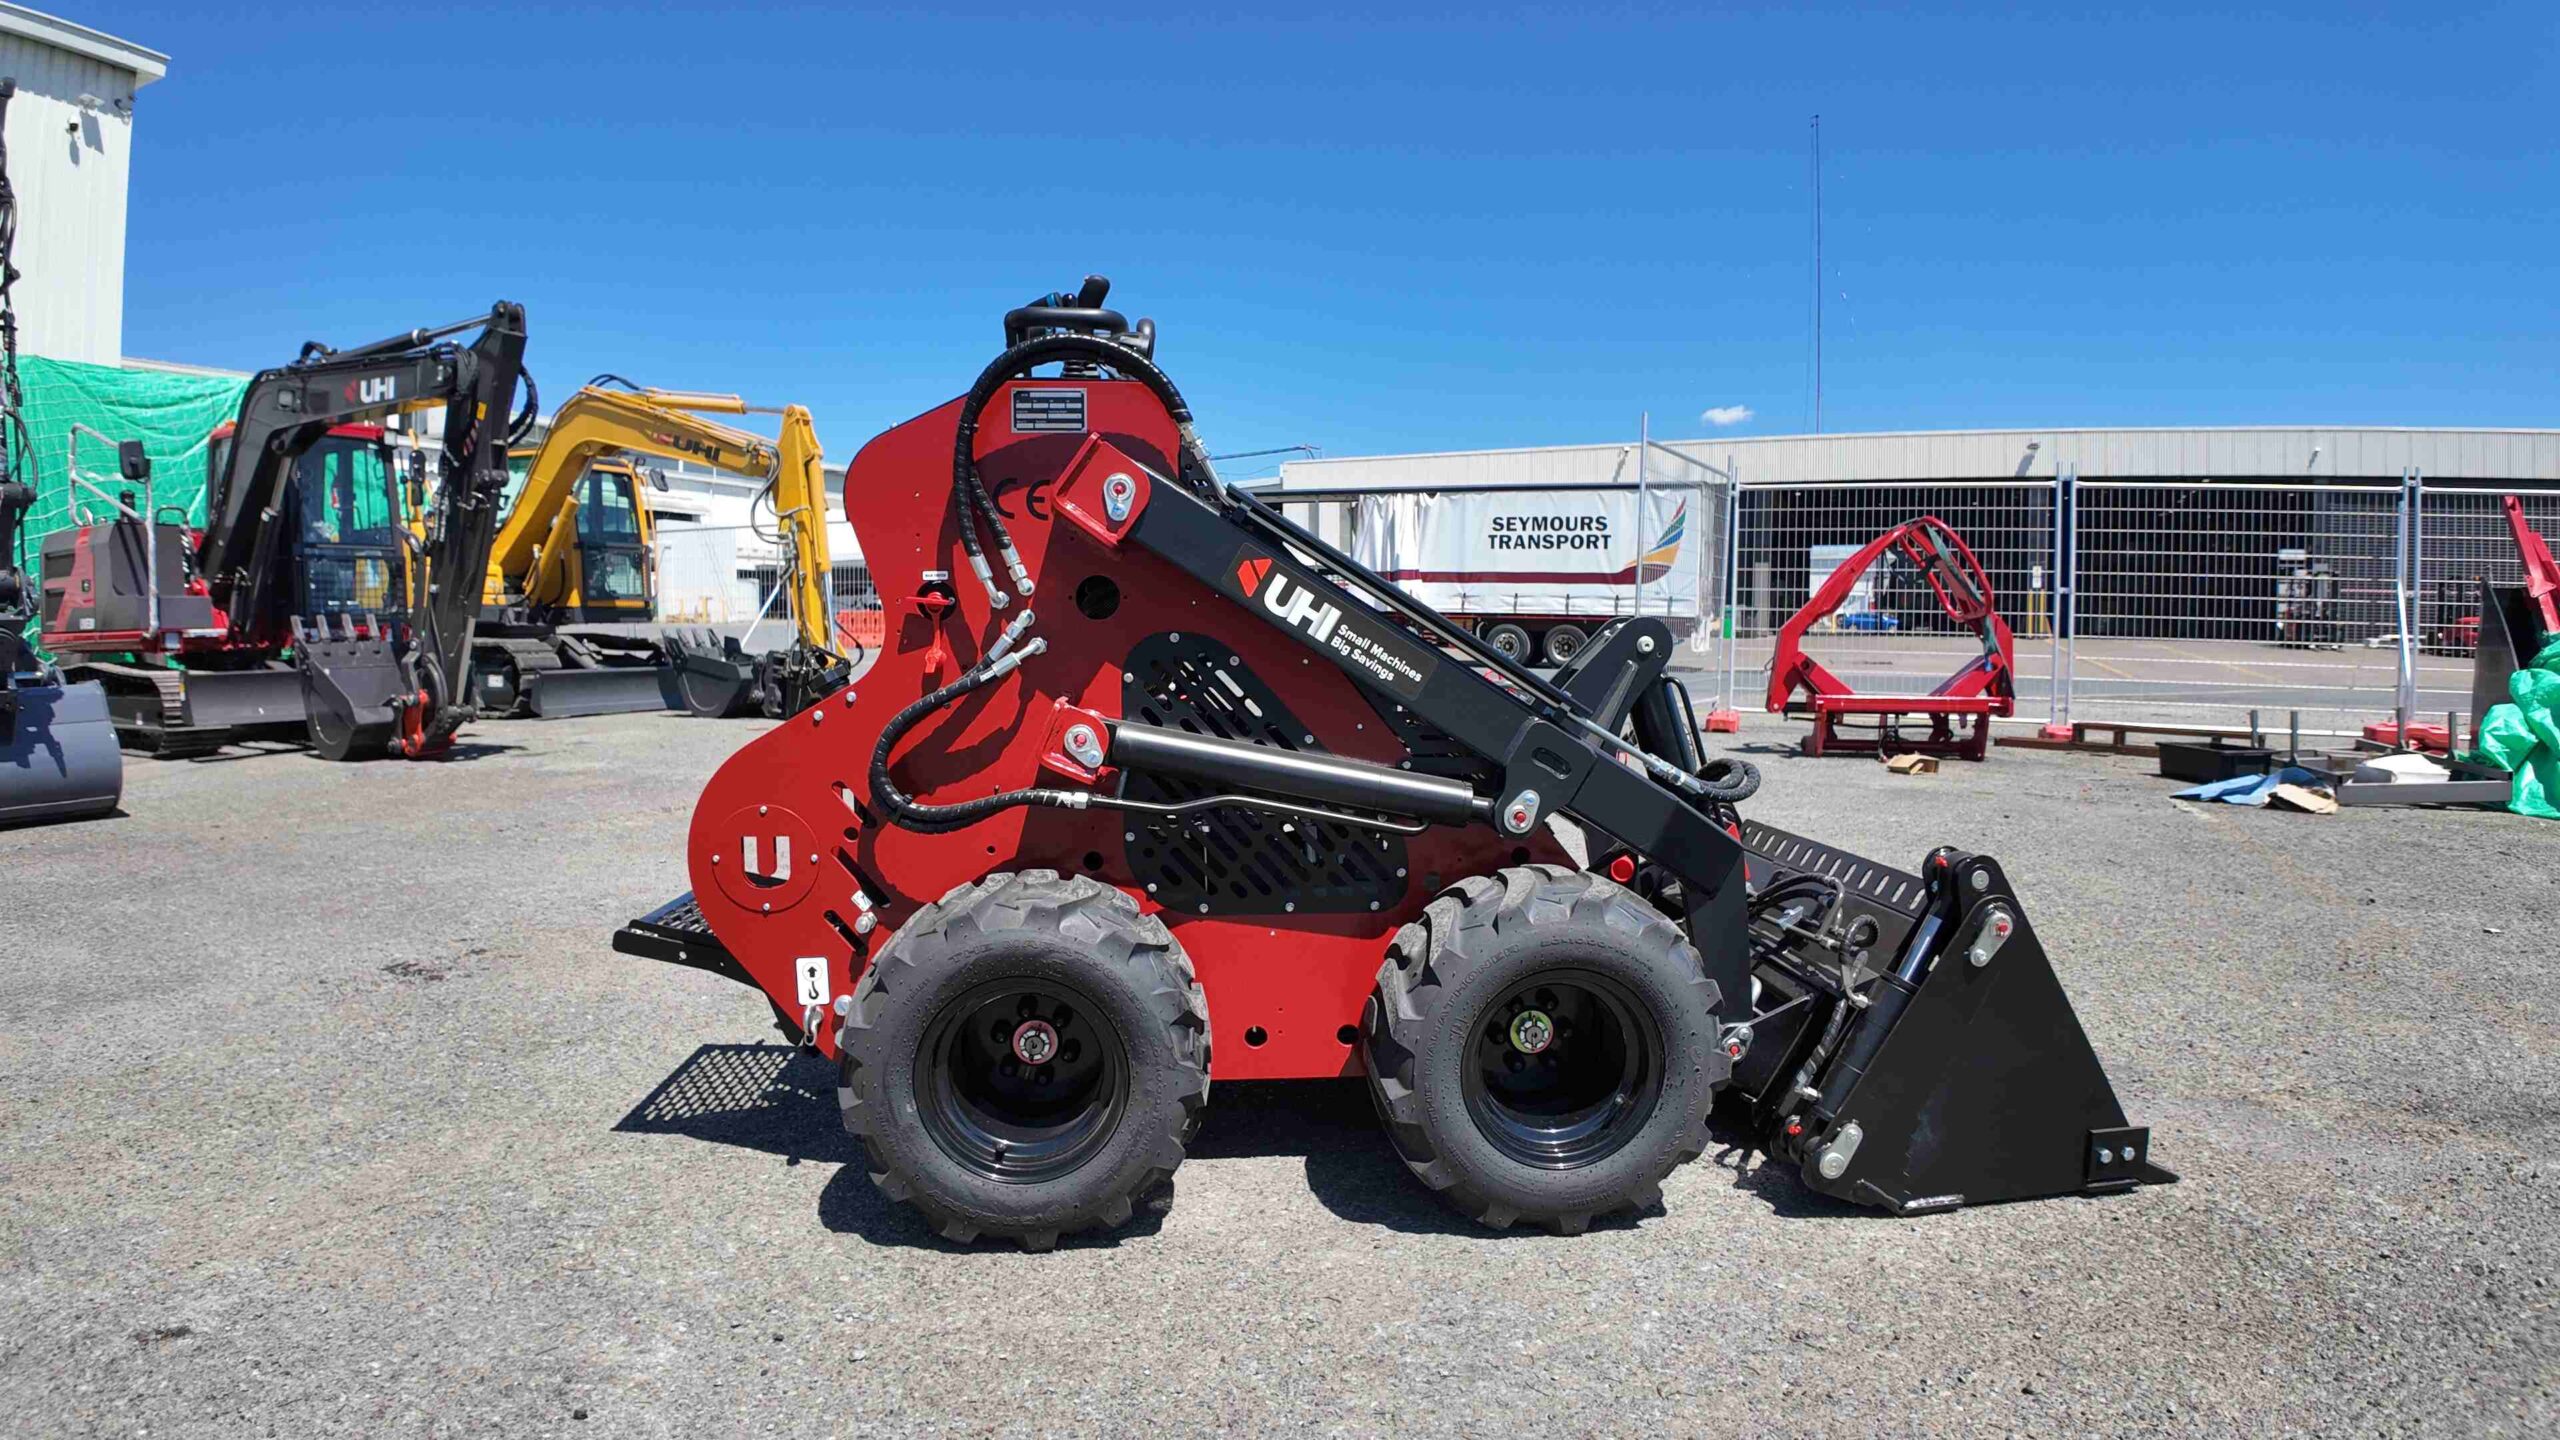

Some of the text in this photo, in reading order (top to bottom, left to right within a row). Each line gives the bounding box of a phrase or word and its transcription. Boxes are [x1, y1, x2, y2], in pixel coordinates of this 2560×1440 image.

[360, 375, 395, 403] UHI
[673, 434, 720, 462] UHI
[991, 478, 1051, 521] CE
[1488, 534, 1612, 549] TRANSPORT
[1492, 516, 1608, 531] SEYMOURS
[1264, 572, 1342, 643] UHI
[1330, 635, 1395, 682] Big Savings
[1337, 623, 1423, 683] Small Machines
[741, 836, 791, 889] U
